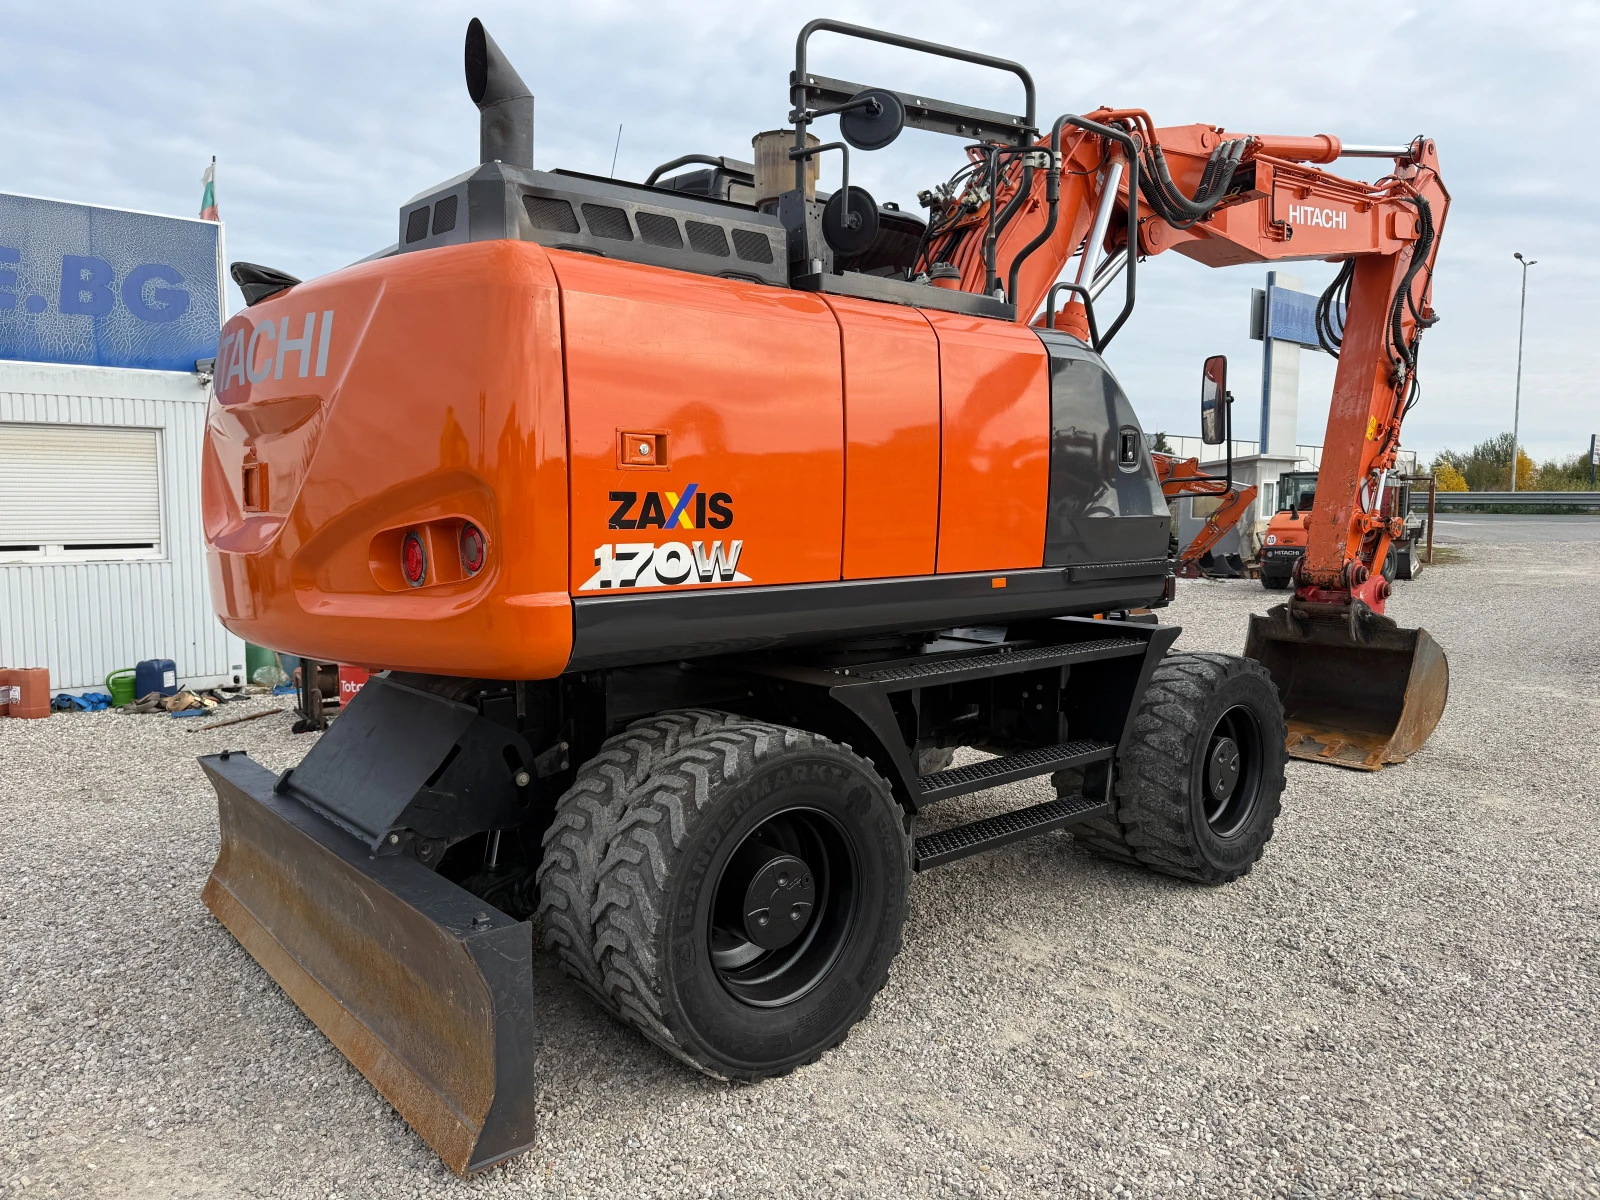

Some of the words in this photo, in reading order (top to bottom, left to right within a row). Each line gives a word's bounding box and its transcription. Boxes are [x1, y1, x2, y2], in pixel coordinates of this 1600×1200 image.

[1289, 204, 1347, 230] HITACHI
[213, 310, 335, 394] ITACHI
[608, 483, 734, 530] ZAXIS
[1267, 536, 1275, 544] 20
[594, 540, 744, 589] 170W
